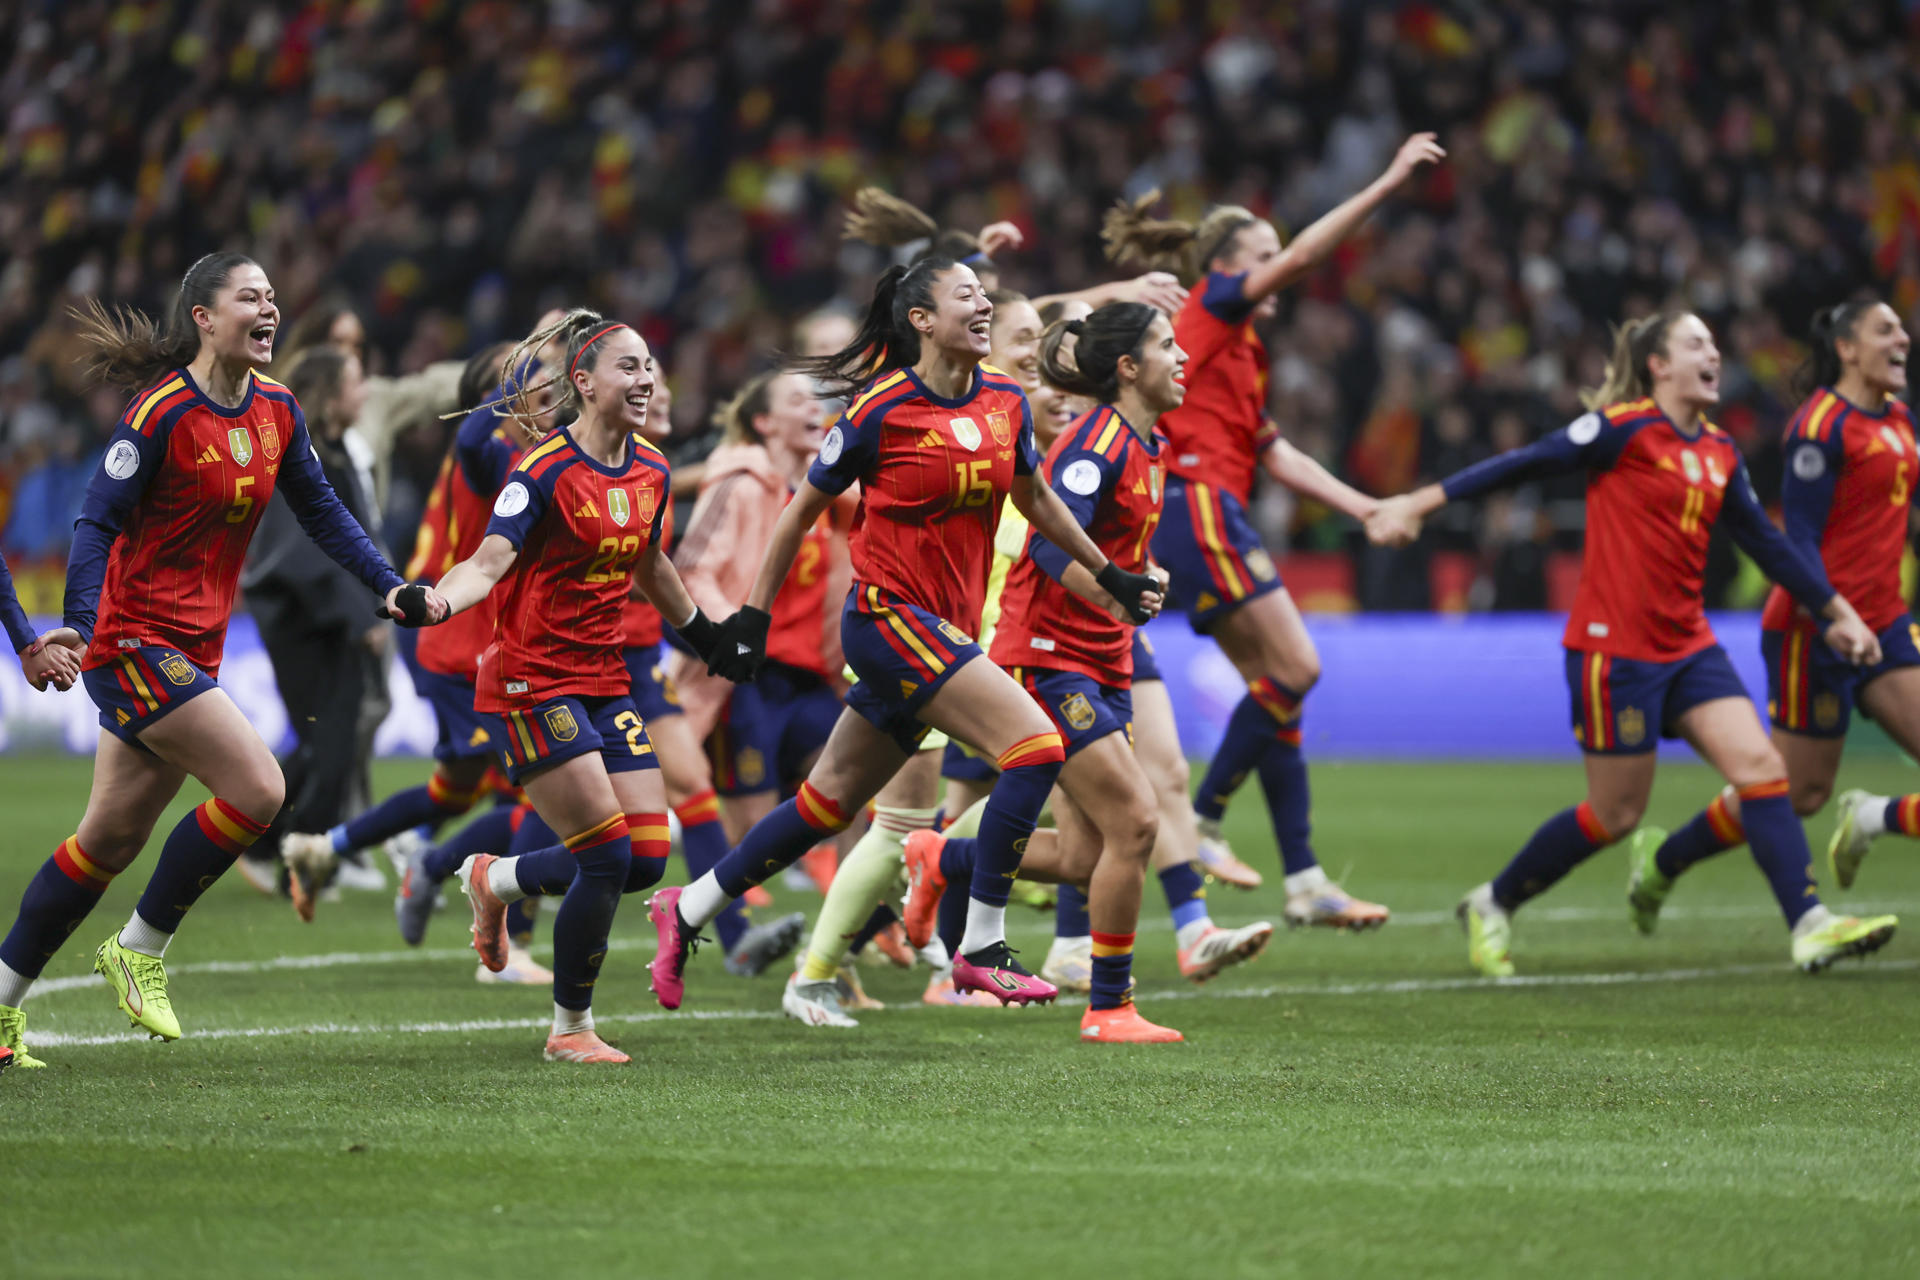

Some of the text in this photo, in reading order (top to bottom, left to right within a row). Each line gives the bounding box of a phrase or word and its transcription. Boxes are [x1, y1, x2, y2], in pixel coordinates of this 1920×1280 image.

[225, 475, 255, 523] 5
[953, 459, 993, 508] 15
[584, 535, 640, 583] 22
[1133, 512, 1160, 563] 1
